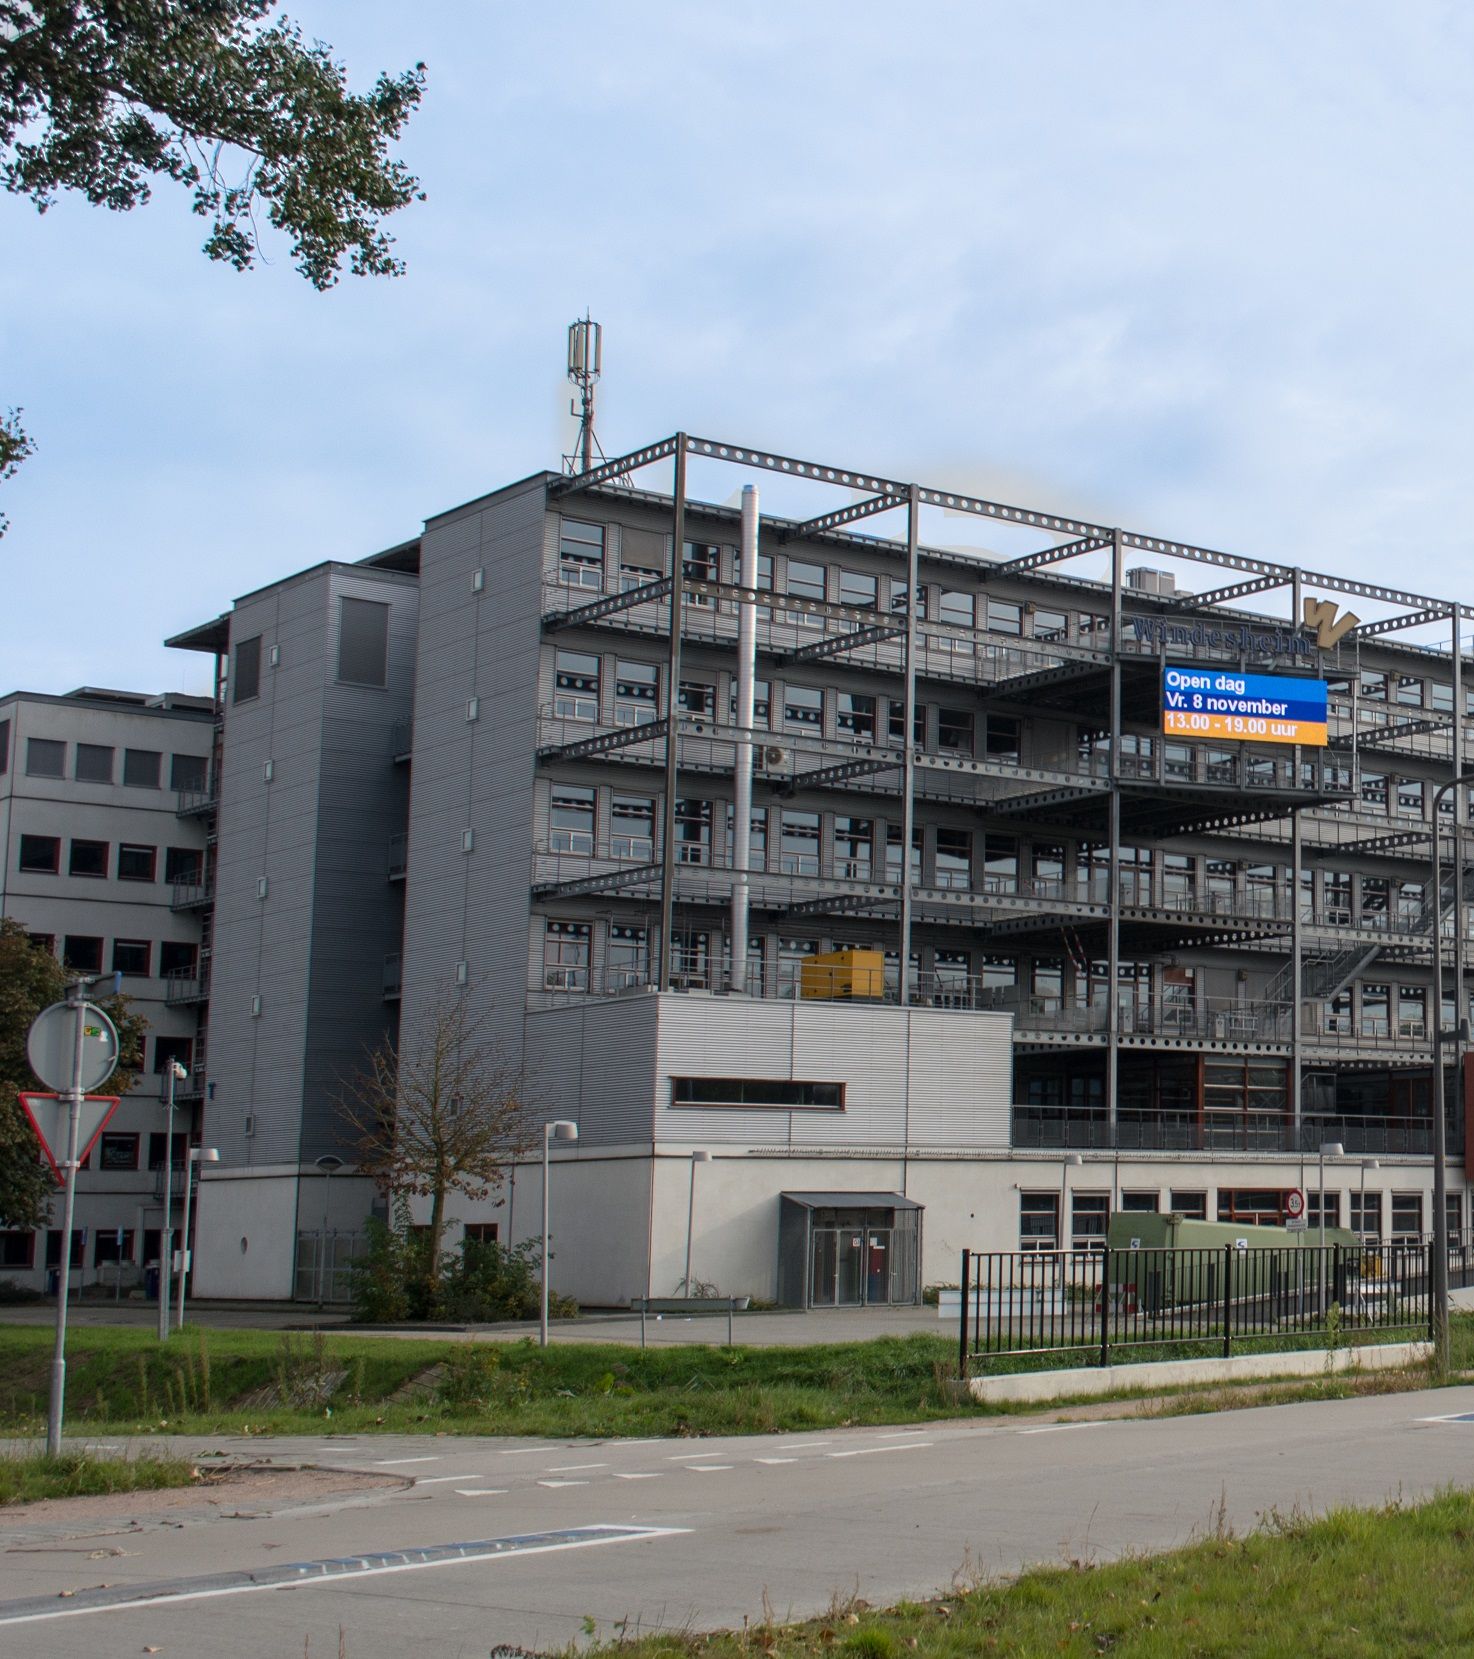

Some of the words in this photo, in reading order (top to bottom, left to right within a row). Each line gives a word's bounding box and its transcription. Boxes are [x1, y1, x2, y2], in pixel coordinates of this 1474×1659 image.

[1131, 615, 1311, 656] Windesheim
[1166, 671, 1210, 690] Open
[1215, 675, 1245, 695] dag
[1166, 691, 1188, 708] Vr.
[1193, 694, 1203, 709] 8
[1207, 697, 1288, 716] november
[1167, 712, 1210, 730] 13.00
[1225, 717, 1267, 735] 19.00
[1271, 723, 1298, 737] uur
